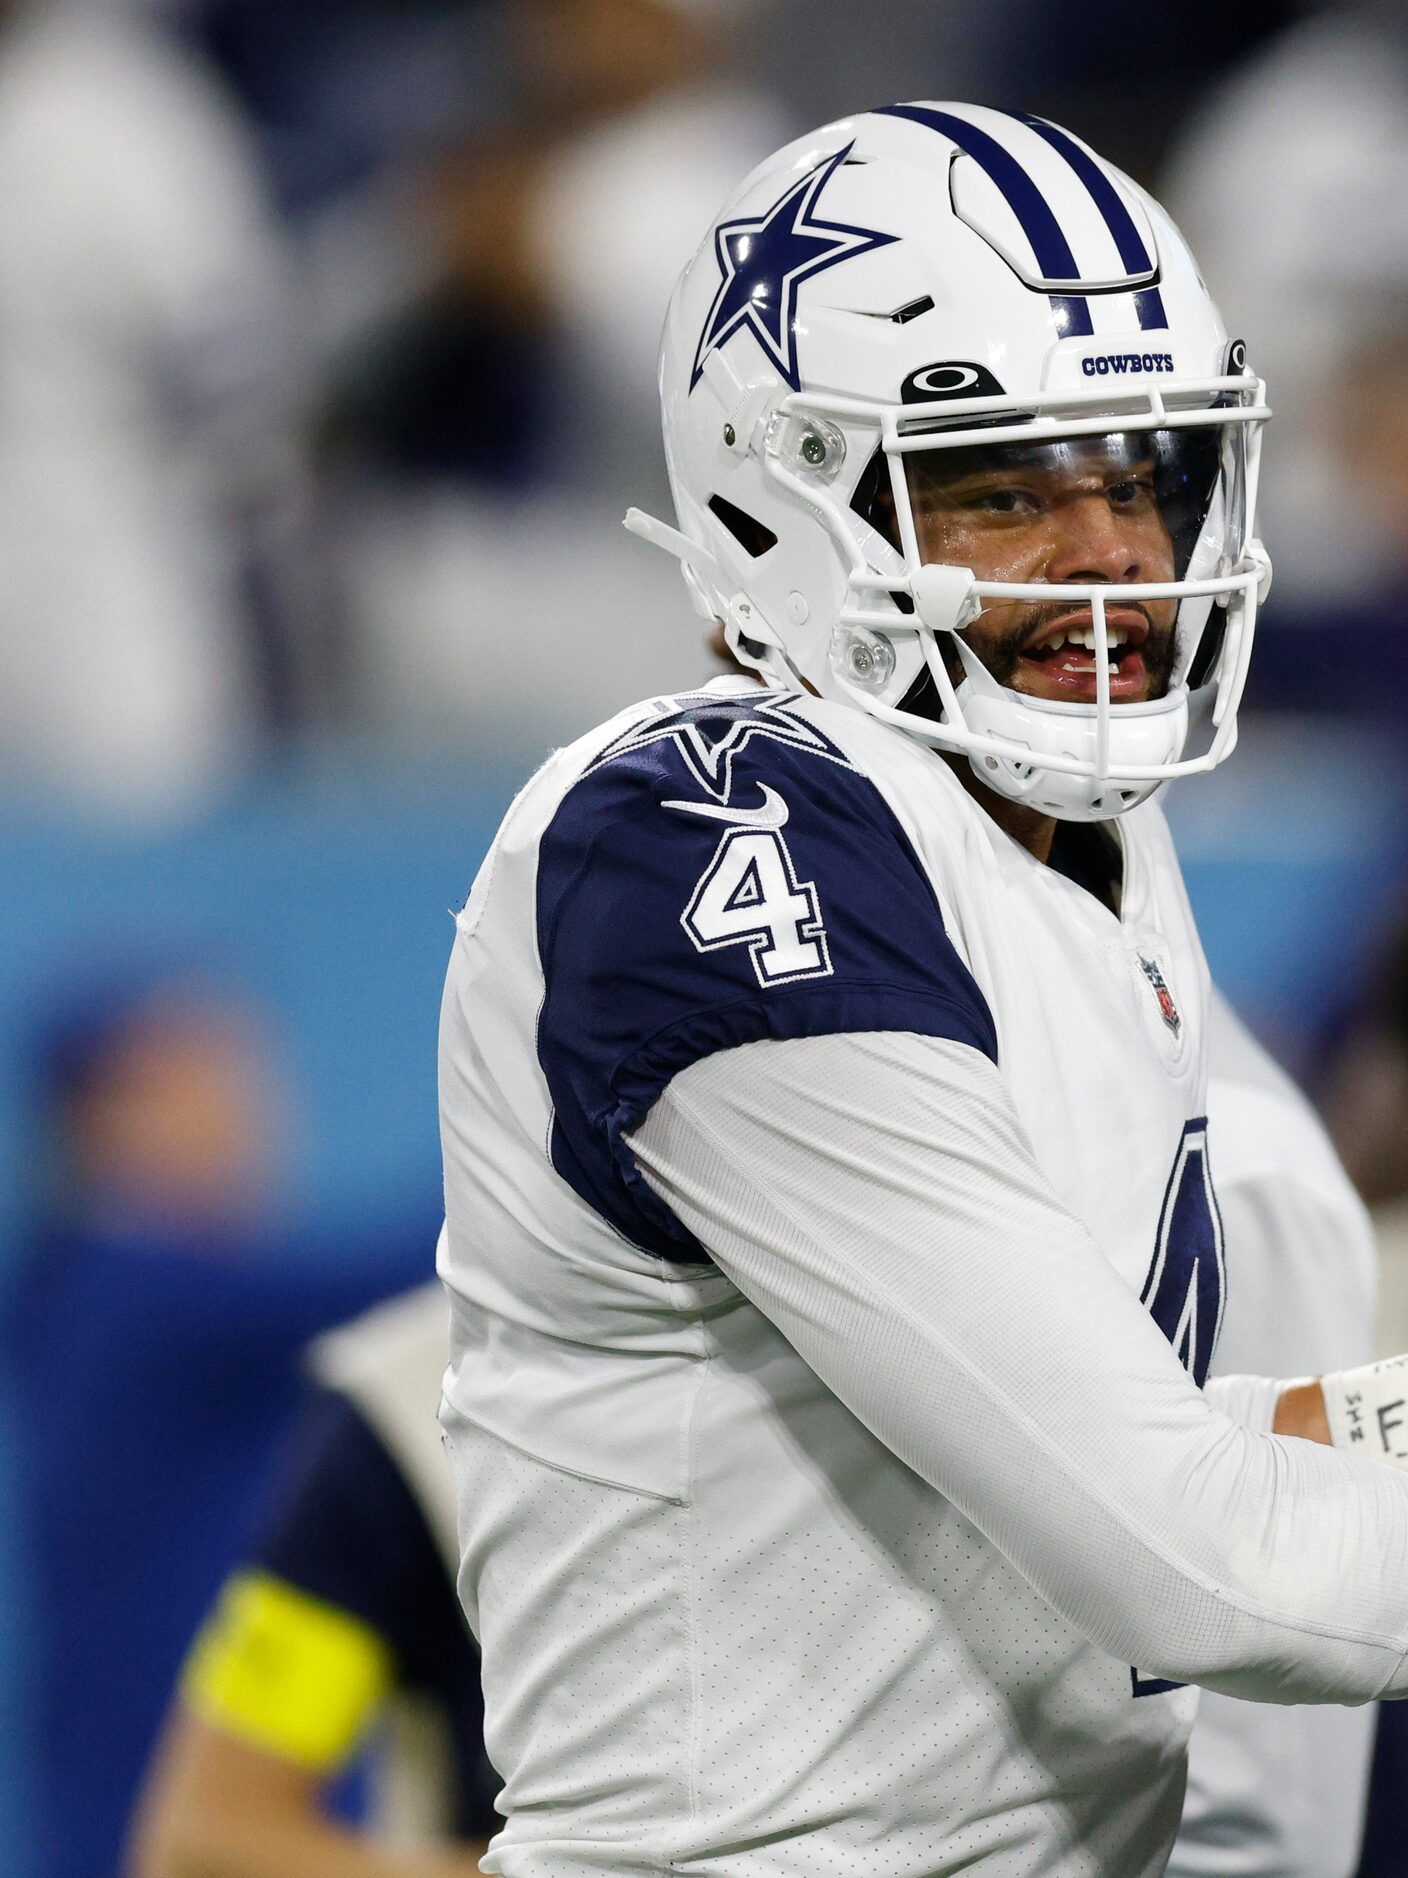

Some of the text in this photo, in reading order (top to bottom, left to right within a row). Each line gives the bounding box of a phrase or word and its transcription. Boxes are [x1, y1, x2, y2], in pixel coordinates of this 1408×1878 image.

[1081, 353, 1175, 377] COWBOYS
[679, 825, 835, 989] 4
[1345, 1390, 1365, 1443] WIN
